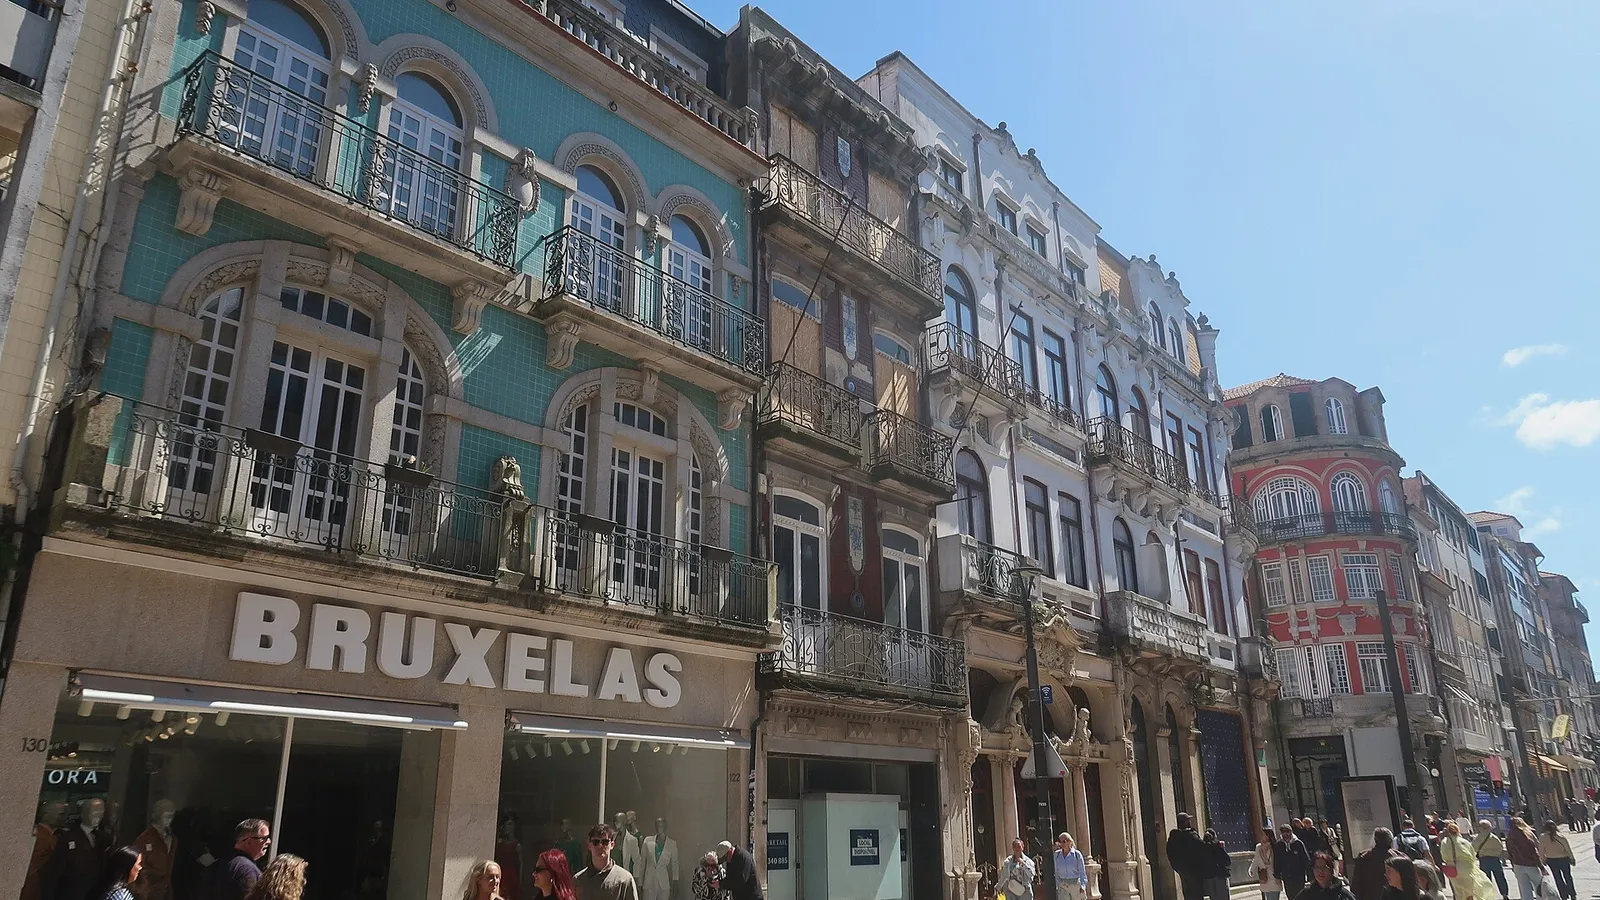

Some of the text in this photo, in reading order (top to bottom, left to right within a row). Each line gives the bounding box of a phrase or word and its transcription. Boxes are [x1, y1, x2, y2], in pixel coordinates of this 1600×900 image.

[229, 592, 682, 708] BRUXELAS
[21, 737, 48, 752] 130
[729, 773, 741, 782] 122
